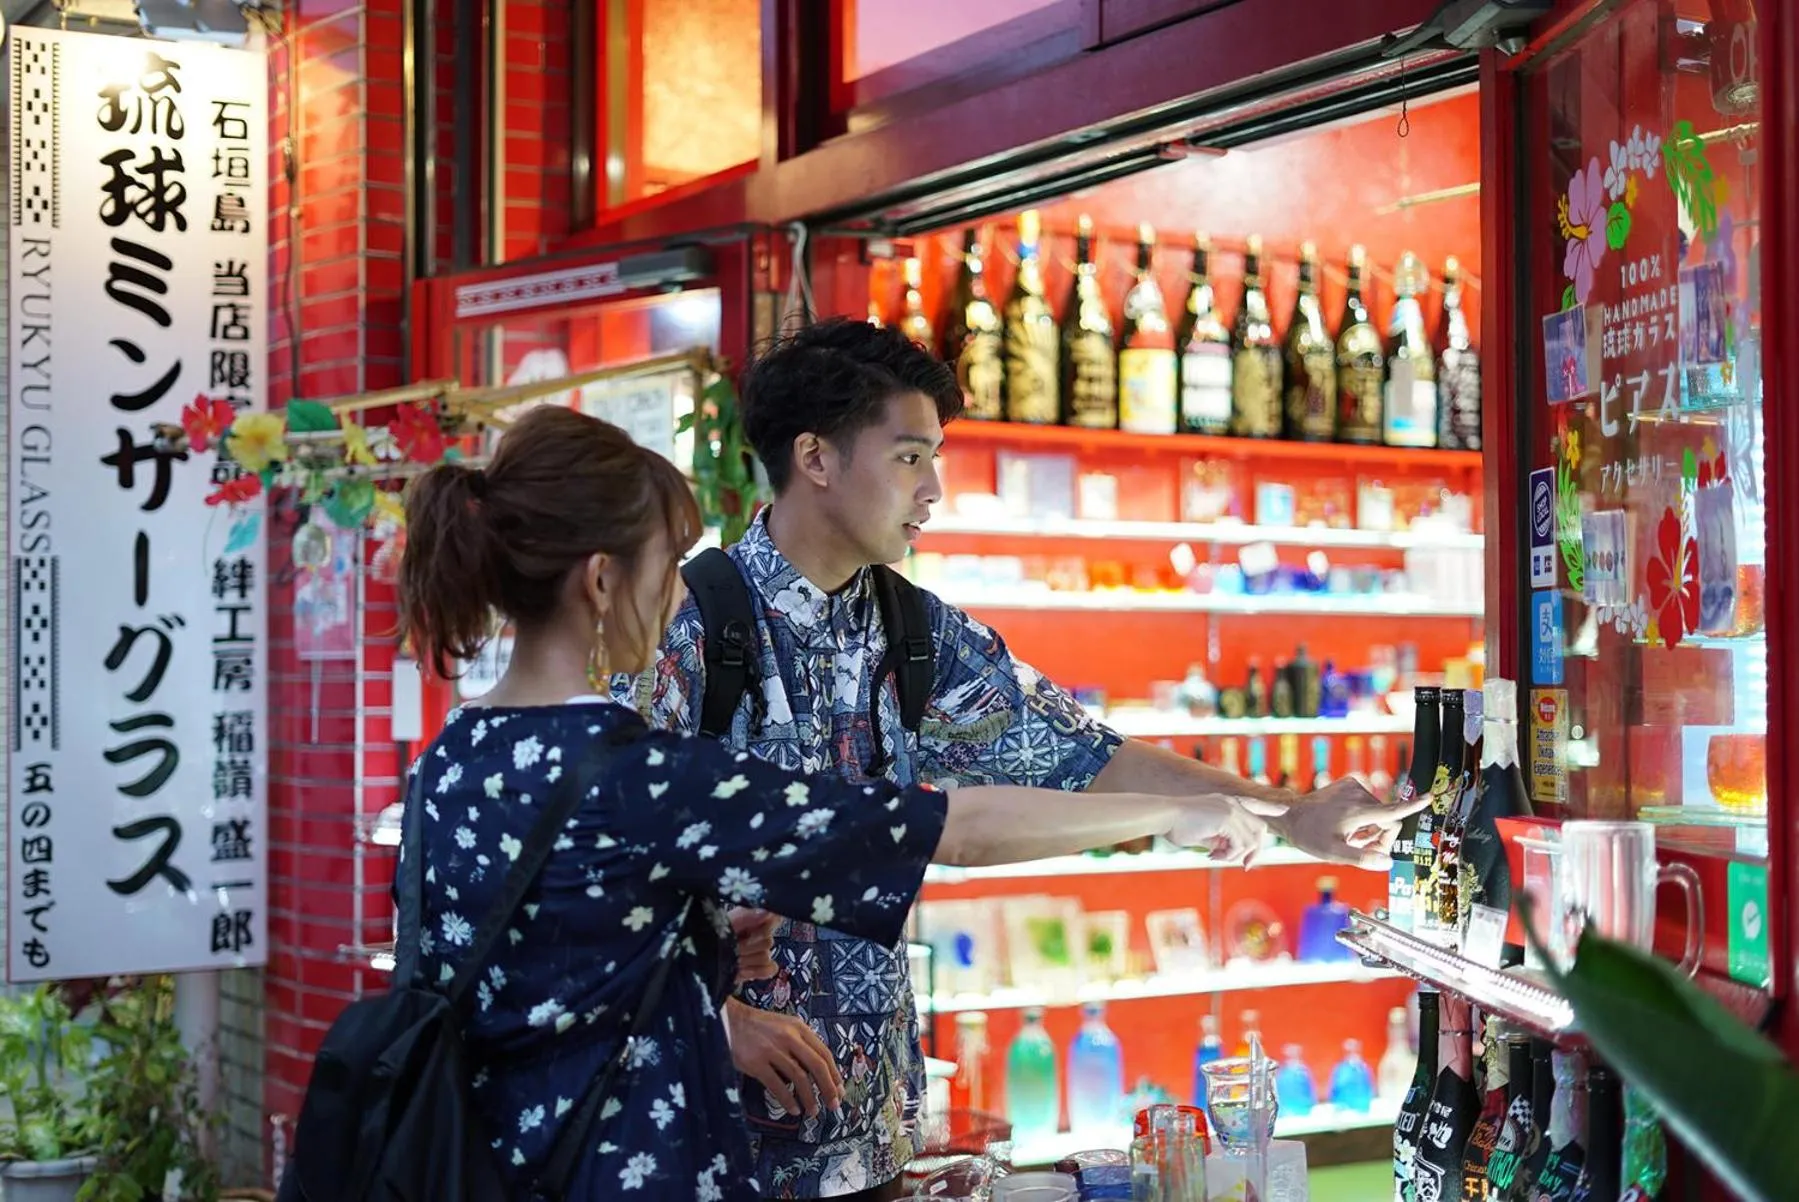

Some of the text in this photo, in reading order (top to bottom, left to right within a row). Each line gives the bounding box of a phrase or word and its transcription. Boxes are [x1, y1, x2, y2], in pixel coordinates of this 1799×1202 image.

[211, 101, 251, 234] 石垣島
[1604, 285, 1677, 327] HANDMADE
[1621, 253, 1661, 289] 100%
[1603, 313, 1675, 359] 琉球ガラス
[20, 237, 53, 553] RYUKYU GLASS
[1600, 361, 1680, 438] ピアス
[97, 52, 191, 895] 琉球ミンサーグラス
[1600, 453, 1678, 494] アクセサリー
[21, 763, 56, 968] 五の四までも
[210, 819, 254, 953] 盛一郎
